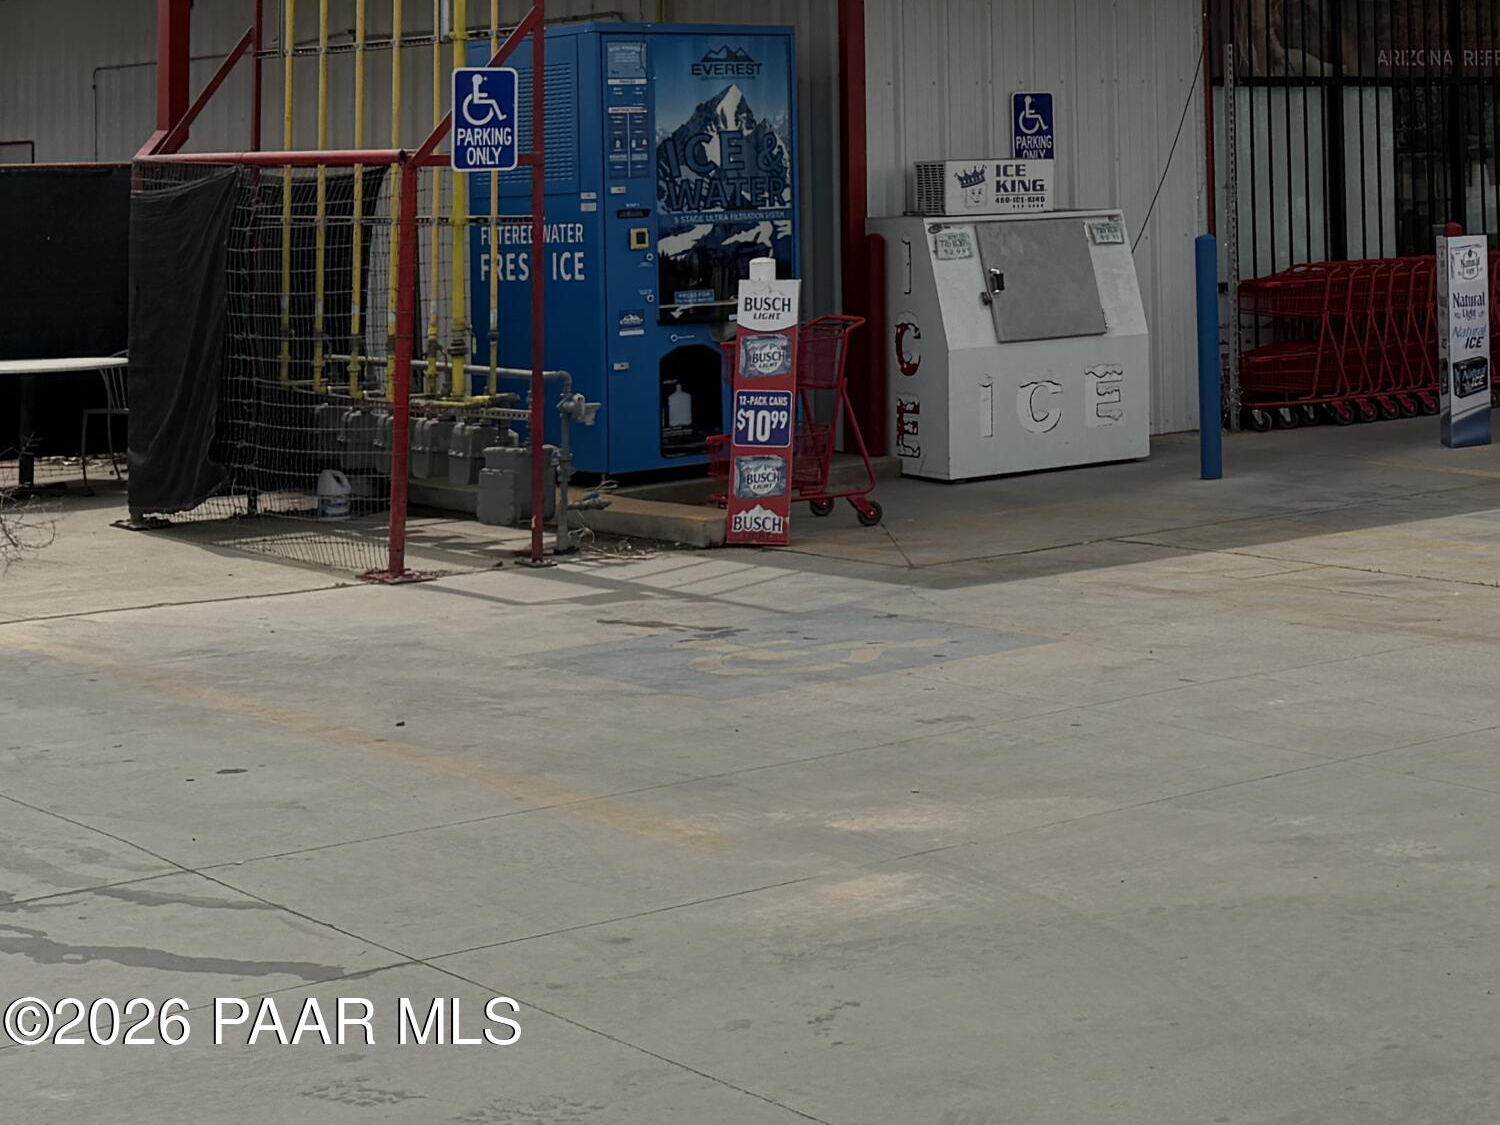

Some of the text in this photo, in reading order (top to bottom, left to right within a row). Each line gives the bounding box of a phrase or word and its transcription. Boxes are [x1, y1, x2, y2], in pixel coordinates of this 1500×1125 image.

[1377, 49, 1455, 67] ARIZONA
[691, 63, 762, 76] EVEREST
[456, 127, 513, 146] PARKING
[1015, 135, 1053, 150] PARKING
[466, 147, 502, 166] ONLY
[664, 131, 745, 178] ICE
[756, 132, 784, 174] &
[1022, 148, 1046, 159] ONLY
[995, 164, 1026, 177] ICE
[995, 179, 1045, 193] KING
[666, 176, 786, 212] WATER
[481, 225, 533, 245] FITERED
[480, 251, 585, 282] FRES ICE
[744, 297, 791, 312] BUSCH
[1453, 291, 1485, 308] Natural
[1465, 337, 1484, 349] ICE
[752, 351, 785, 364] BUSCH
[738, 396, 788, 407] 12-PACK CANS
[746, 472, 780, 485] BUSCH
[732, 516, 783, 532] BUSCH
